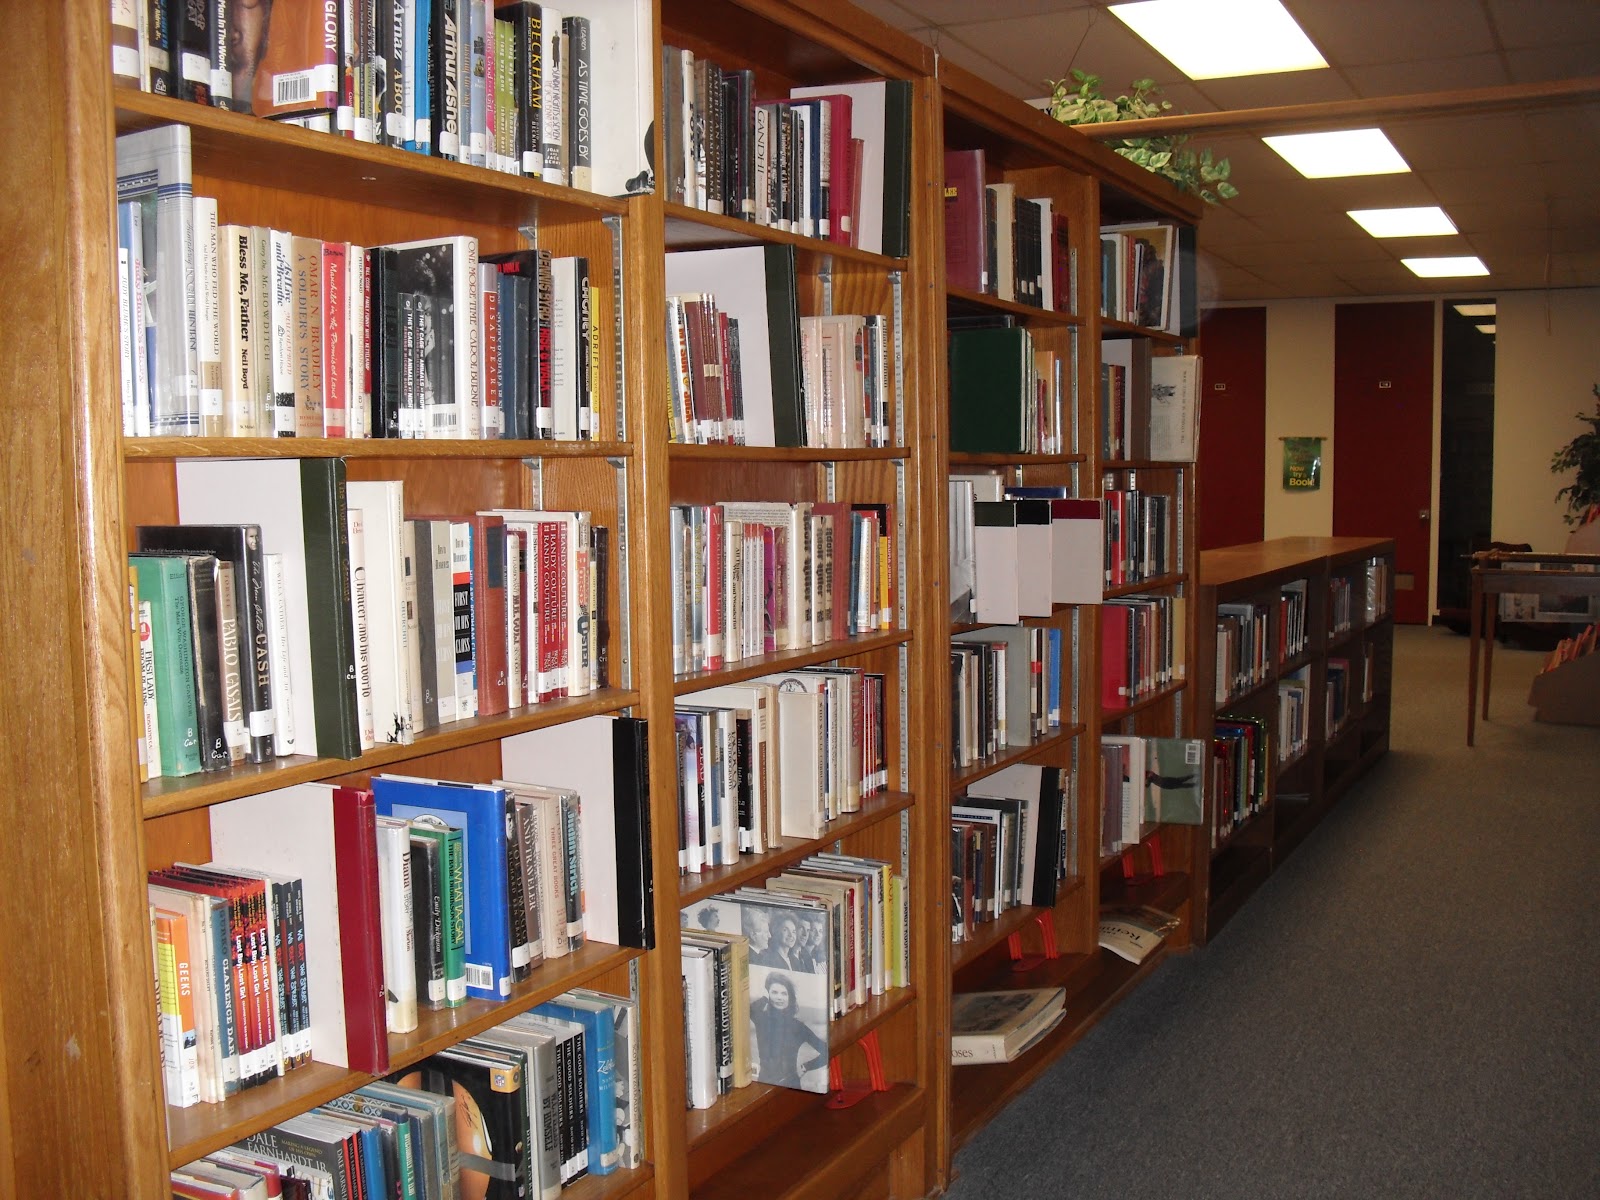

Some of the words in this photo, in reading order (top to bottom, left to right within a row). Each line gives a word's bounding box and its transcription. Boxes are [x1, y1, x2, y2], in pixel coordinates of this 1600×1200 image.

[217, 0, 226, 18] Man
[218, 19, 226, 28] In
[218, 29, 227, 46] The
[324, 1, 337, 53] GLORY
[393, 0, 405, 60] Arnaz
[218, 46, 227, 71] World
[444, 13, 457, 82] Arthur
[530, 17, 542, 109] BECKHAM
[578, 59, 588, 77] AS
[552, 69, 560, 92] SUNDAY
[578, 81, 588, 103] TIME
[445, 78, 458, 134] Ashe
[552, 93, 560, 116] NIGHTS
[552, 121, 561, 140] SEVEN
[578, 107, 589, 142] GOES
[578, 144, 588, 160] BY
[757, 110, 765, 174] GANDHI
[238, 235, 249, 269] Bless
[298, 253, 306, 262] A
[467, 241, 476, 264] ONE
[134, 259, 142, 289] Judy
[238, 272, 249, 295] Me,
[276, 264, 286, 307] Breathe
[309, 255, 319, 298] OMAR
[330, 263, 338, 304] Manchild
[468, 266, 477, 298] MORE
[538, 251, 551, 291] DENNIS
[298, 269, 308, 339] SOLDIER'S
[310, 307, 319, 319] N.
[469, 301, 477, 325] TIME
[538, 292, 551, 321] BYRD
[239, 298, 250, 342] Father
[262, 292, 270, 361] BOWDITCH
[330, 317, 338, 329] the
[331, 332, 339, 375] Promised
[470, 329, 478, 369] CAROL
[489, 295, 497, 407] DISAPPEARED
[540, 328, 552, 351] RISE
[300, 347, 310, 391] STORY
[311, 326, 321, 392] BRADLEY
[241, 368, 249, 389] Boyd
[331, 377, 339, 399] Land
[540, 361, 552, 392] WALK
[252, 578, 262, 601] Man
[454, 591, 468, 608] FIRST
[223, 618, 237, 665] PABLO
[354, 566, 366, 620] Chaucer
[361, 665, 371, 698] world
[455, 637, 471, 653] CLASS
[146, 650, 154, 675] FIRST
[182, 630, 190, 683] WASHINGTON
[256, 632, 270, 688] CASH
[147, 677, 155, 701] LADY
[225, 673, 242, 722] CASALS
[187, 728, 193, 737] B
[215, 738, 222, 748] B
[523, 817, 532, 844] AND
[402, 851, 411, 888] Diana
[509, 851, 517, 893] RICHARD
[524, 847, 536, 911] TRAVELER
[433, 895, 441, 916] Emily
[432, 917, 442, 952] Dickinson
[236, 952, 244, 968] Boy,
[179, 962, 191, 996] GEEKS
[222, 958, 232, 1024] CLARENCE
[237, 968, 245, 986] Lost
[253, 983, 261, 996] Girl
[720, 967, 729, 986] THE
[239, 986, 247, 1000] Girl
[720, 988, 729, 1032] CAMELOT
[722, 1034, 730, 1066] LEGAC
[951, 1050, 973, 1058] oses
[247, 1133, 278, 1148] DALE
[544, 1113, 553, 1152] HIMSELF
[247, 1142, 313, 1168] EARNHARDT
[336, 1148, 344, 1168] DALE
